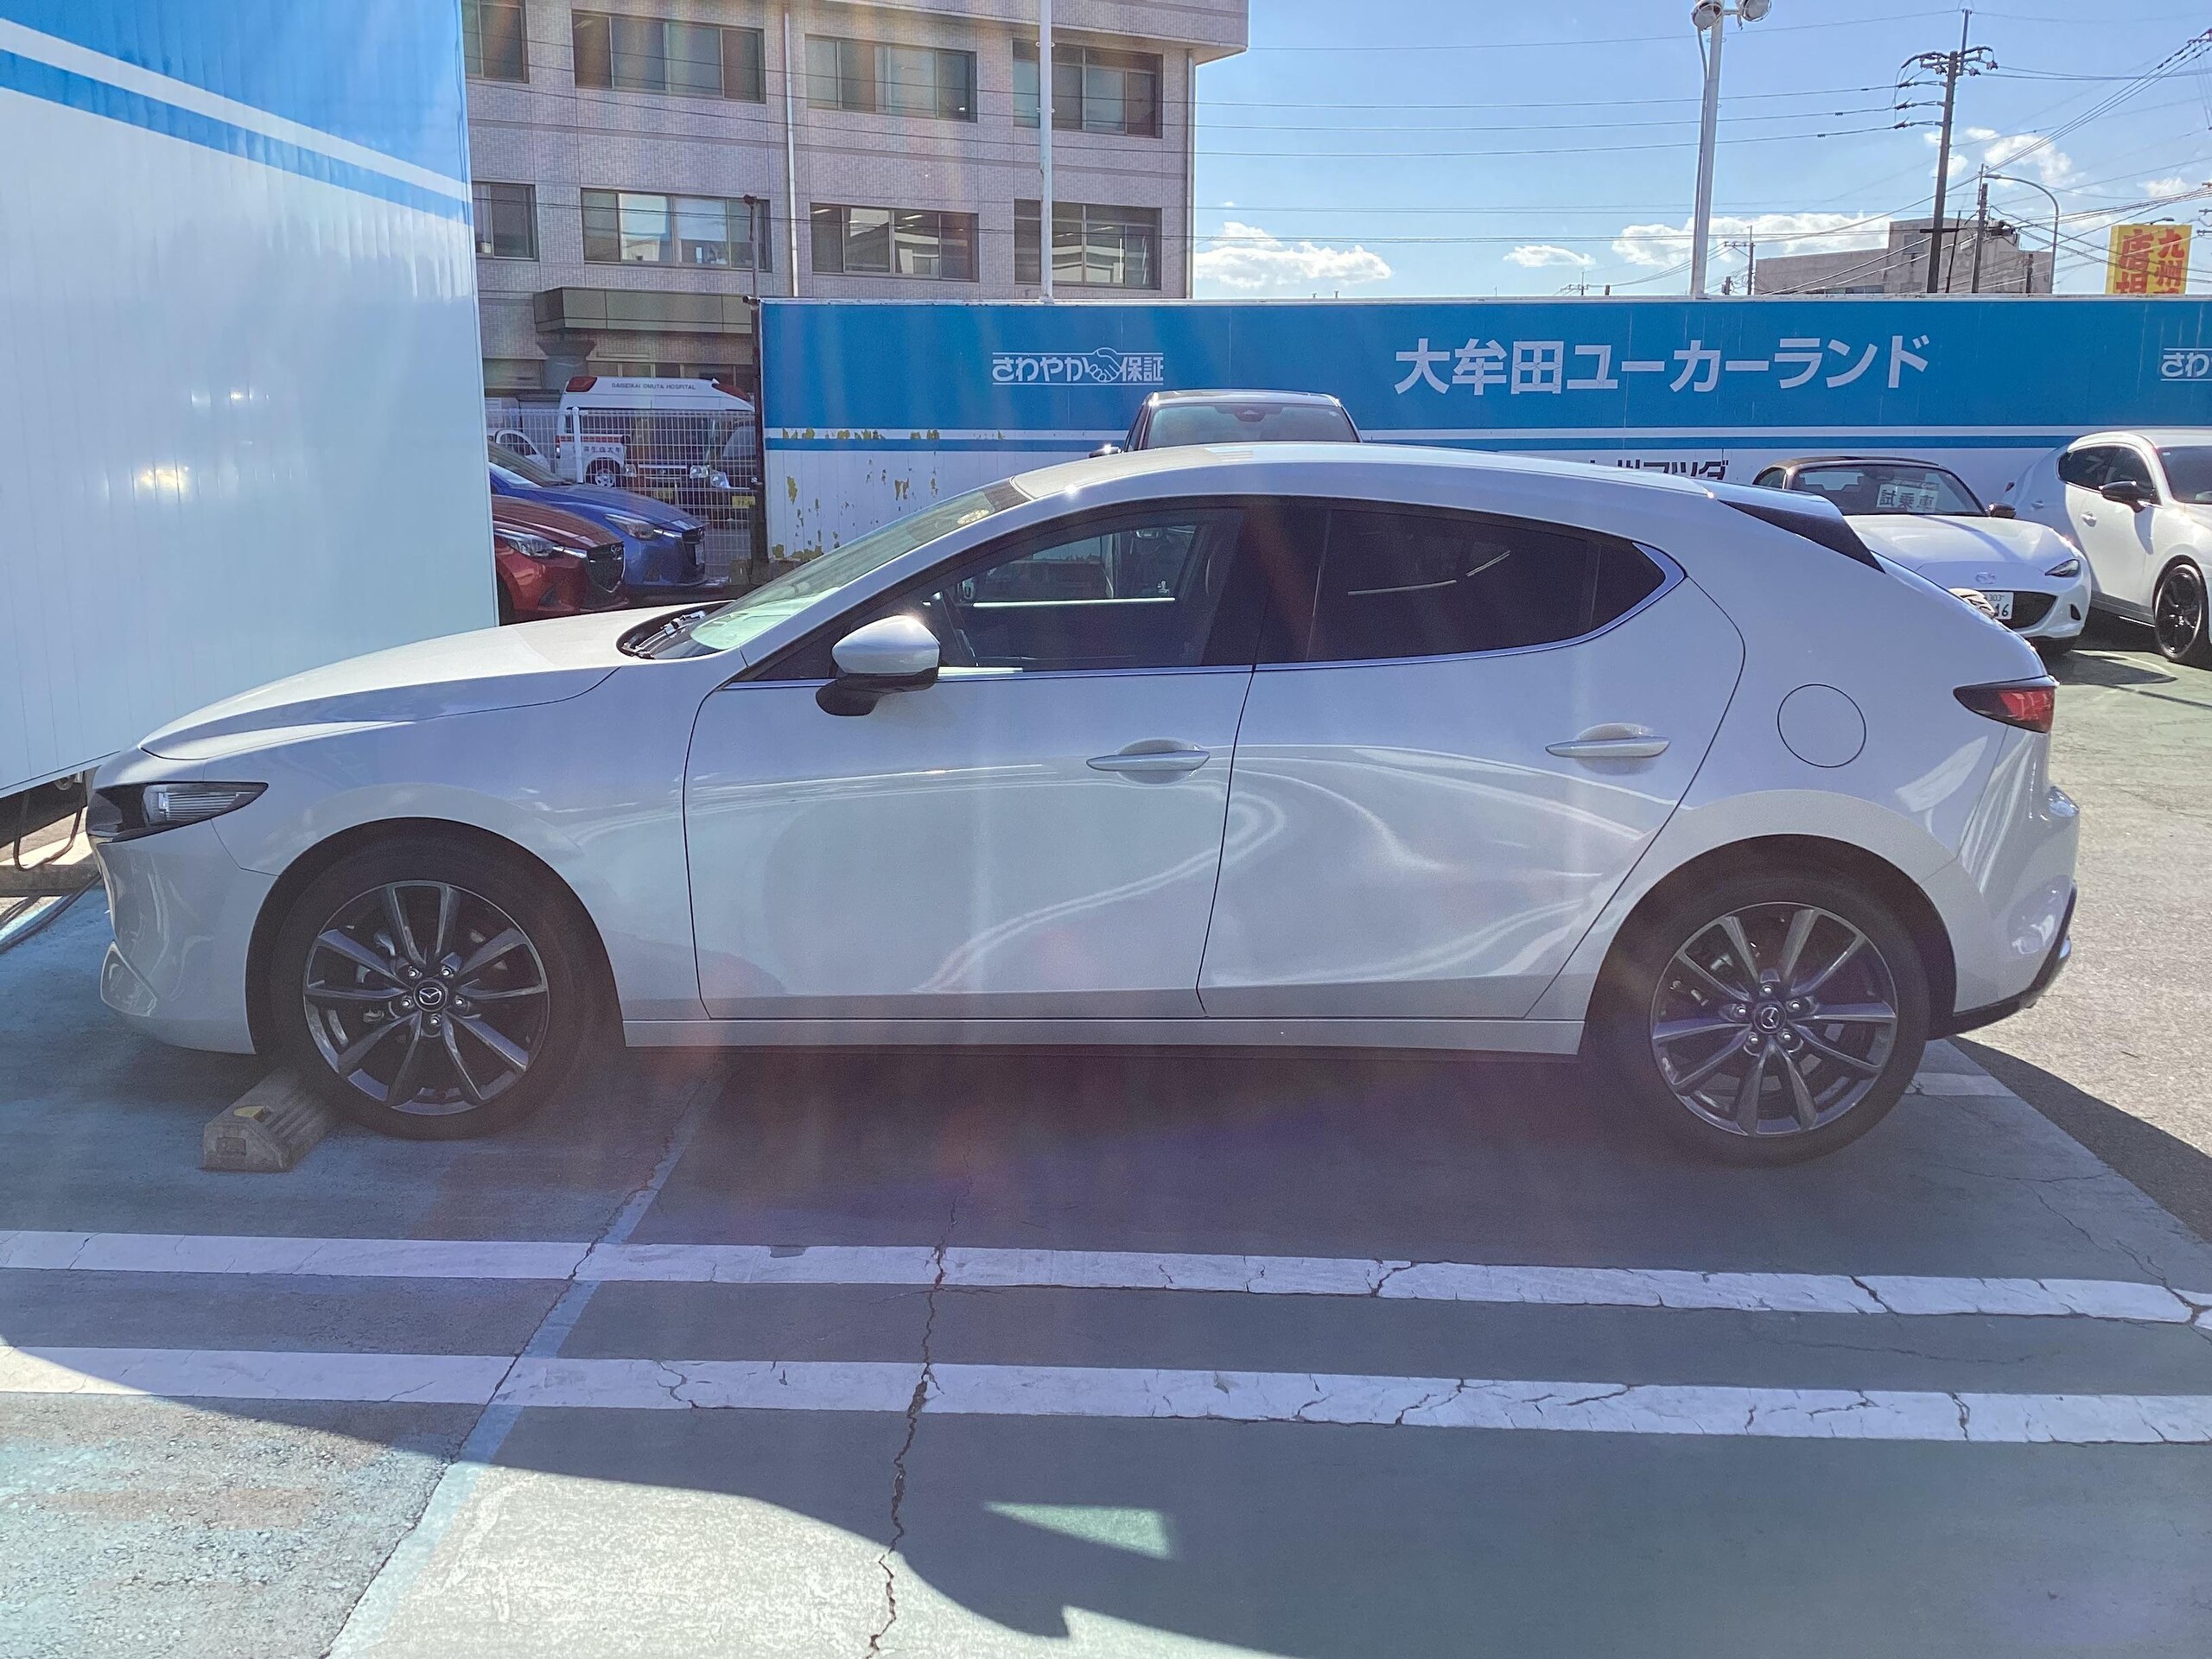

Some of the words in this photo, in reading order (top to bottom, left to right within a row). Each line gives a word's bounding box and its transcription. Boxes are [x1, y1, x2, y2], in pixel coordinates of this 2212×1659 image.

[2154, 227, 2185, 294] 九州
[1395, 334, 1931, 395] 大牟田ユーカーランド
[2161, 352, 2212, 378] さわ
[1879, 489, 1935, 510] 試乗車
[1988, 594, 2002, 602] 303
